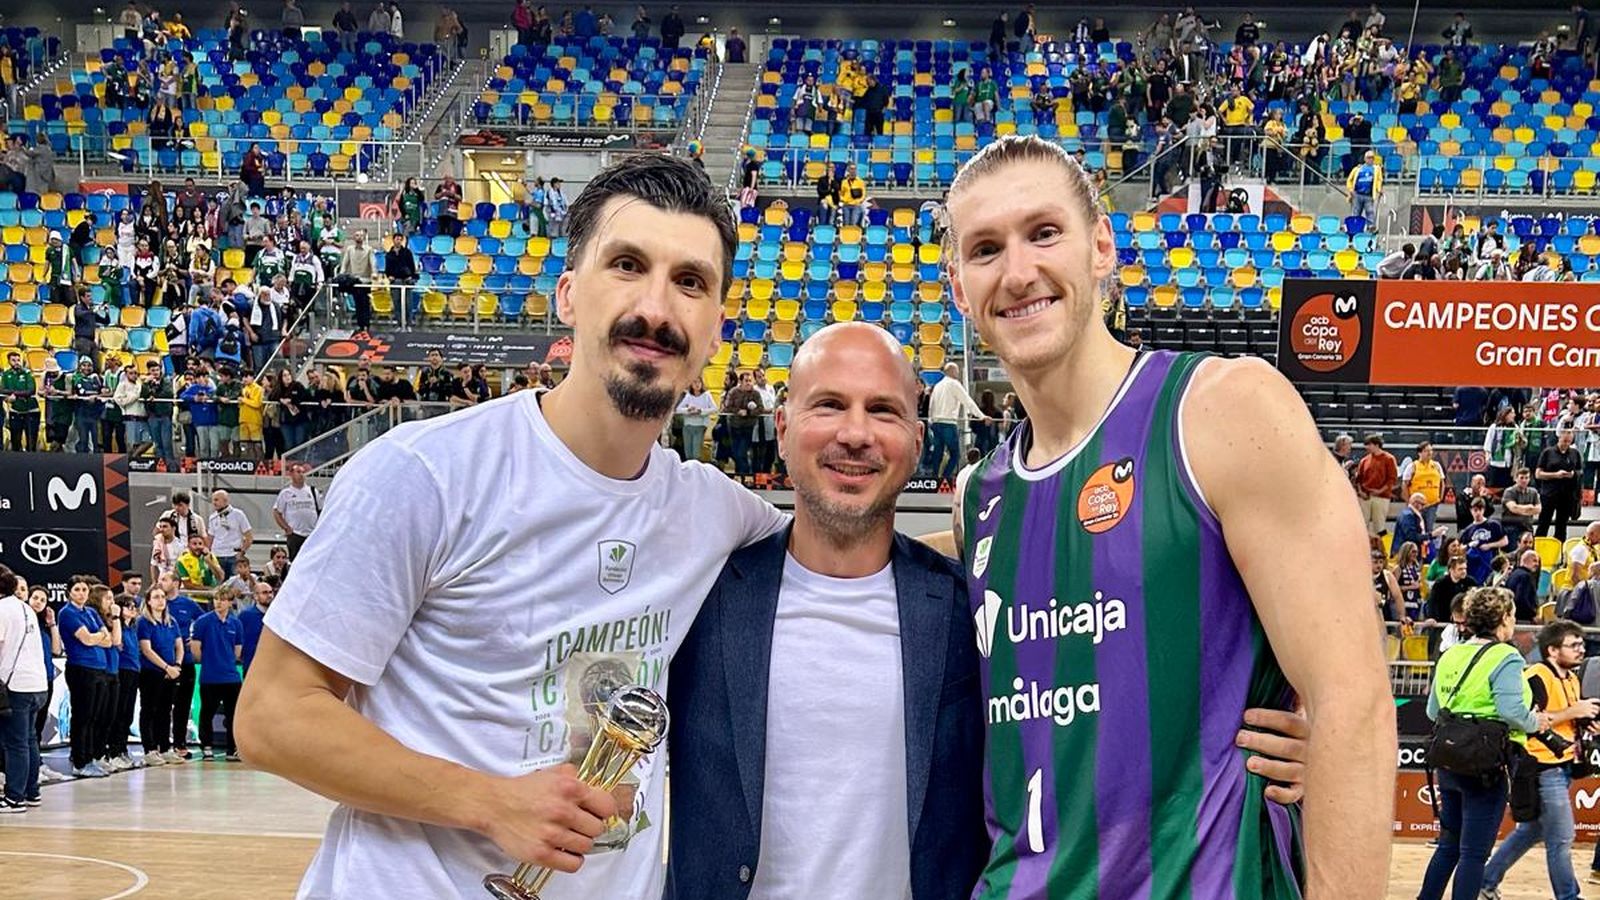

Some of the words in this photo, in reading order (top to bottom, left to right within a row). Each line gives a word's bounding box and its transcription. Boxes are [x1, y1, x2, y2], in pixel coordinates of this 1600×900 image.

[1310, 316, 1329, 325] acb
[1383, 300, 1579, 332] CAMPEONES
[1302, 323, 1339, 340] Copa
[1318, 338, 1342, 354] Rey
[1475, 341, 1542, 367] Gran
[1088, 491, 1116, 506] Copa
[1007, 591, 1127, 645] Unicaja
[545, 604, 671, 671] ¡CAMPEÓN!
[1027, 767, 1046, 853] 1
